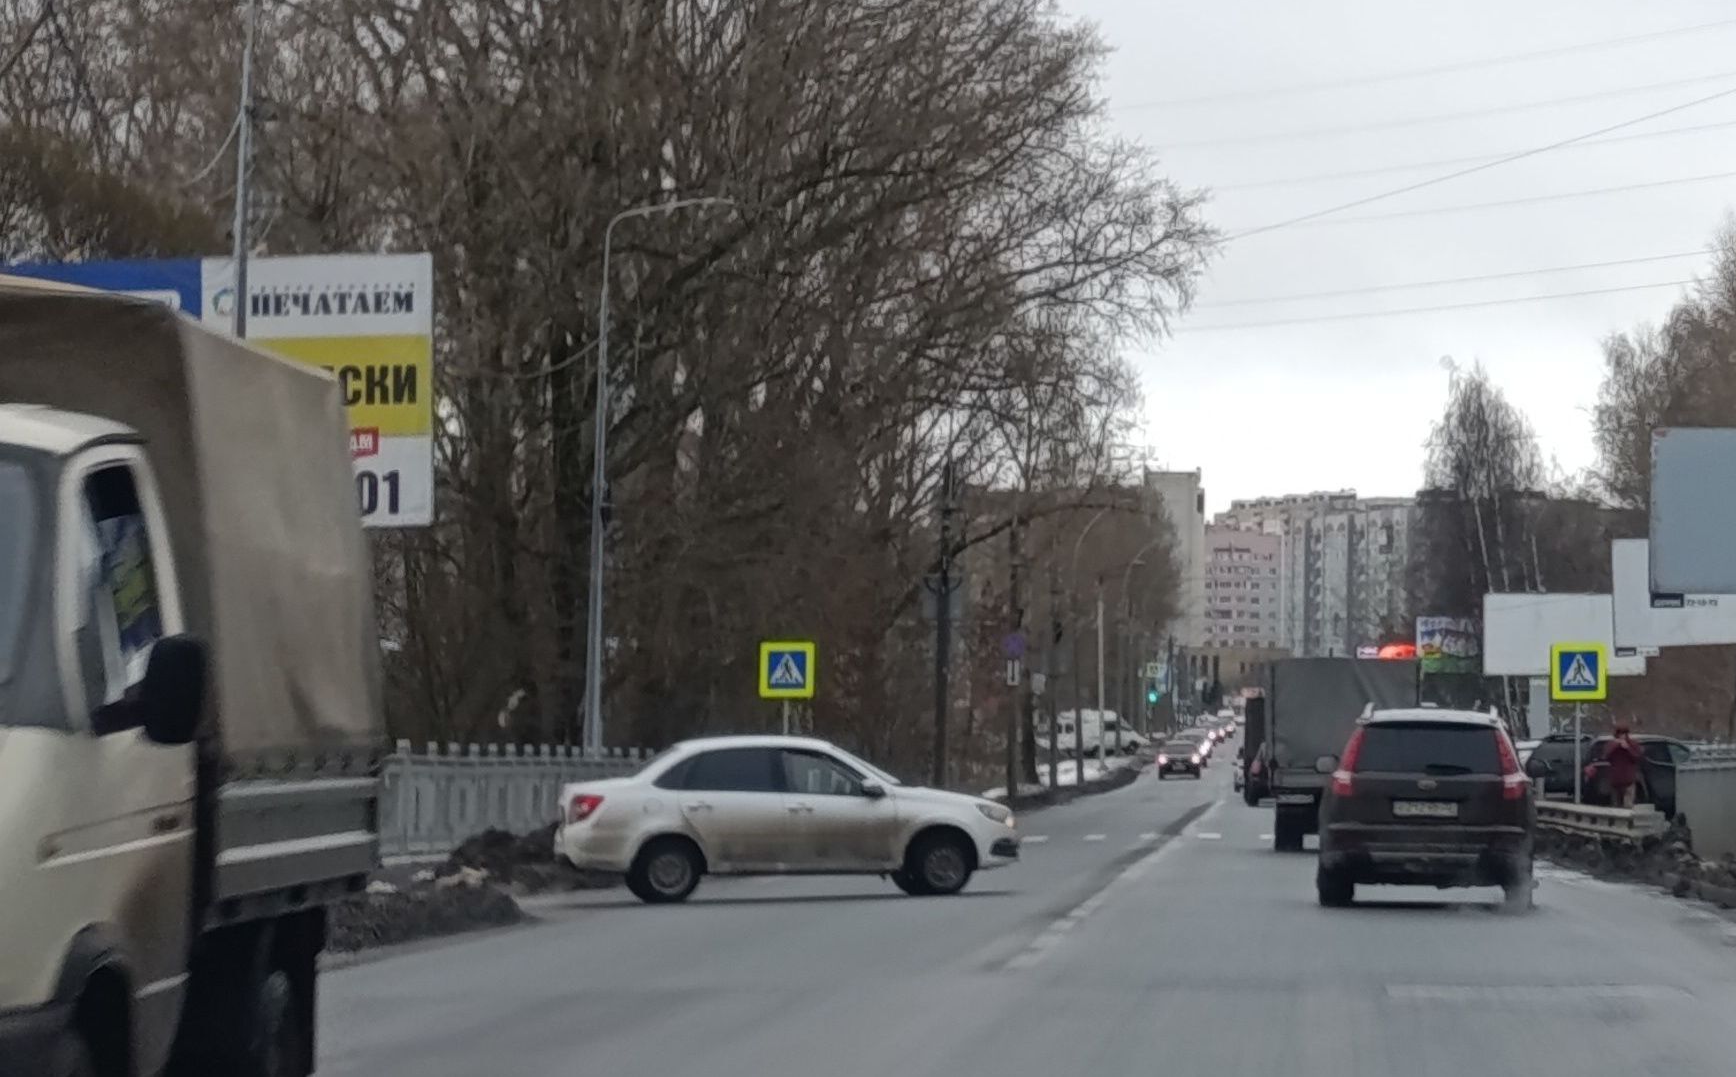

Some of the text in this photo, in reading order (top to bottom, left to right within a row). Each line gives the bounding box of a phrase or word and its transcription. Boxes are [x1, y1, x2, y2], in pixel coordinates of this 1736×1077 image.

[251, 288, 414, 317] ПЕЧАТАЕМ
[321, 364, 417, 406] СКИ
[355, 470, 400, 516] 01
